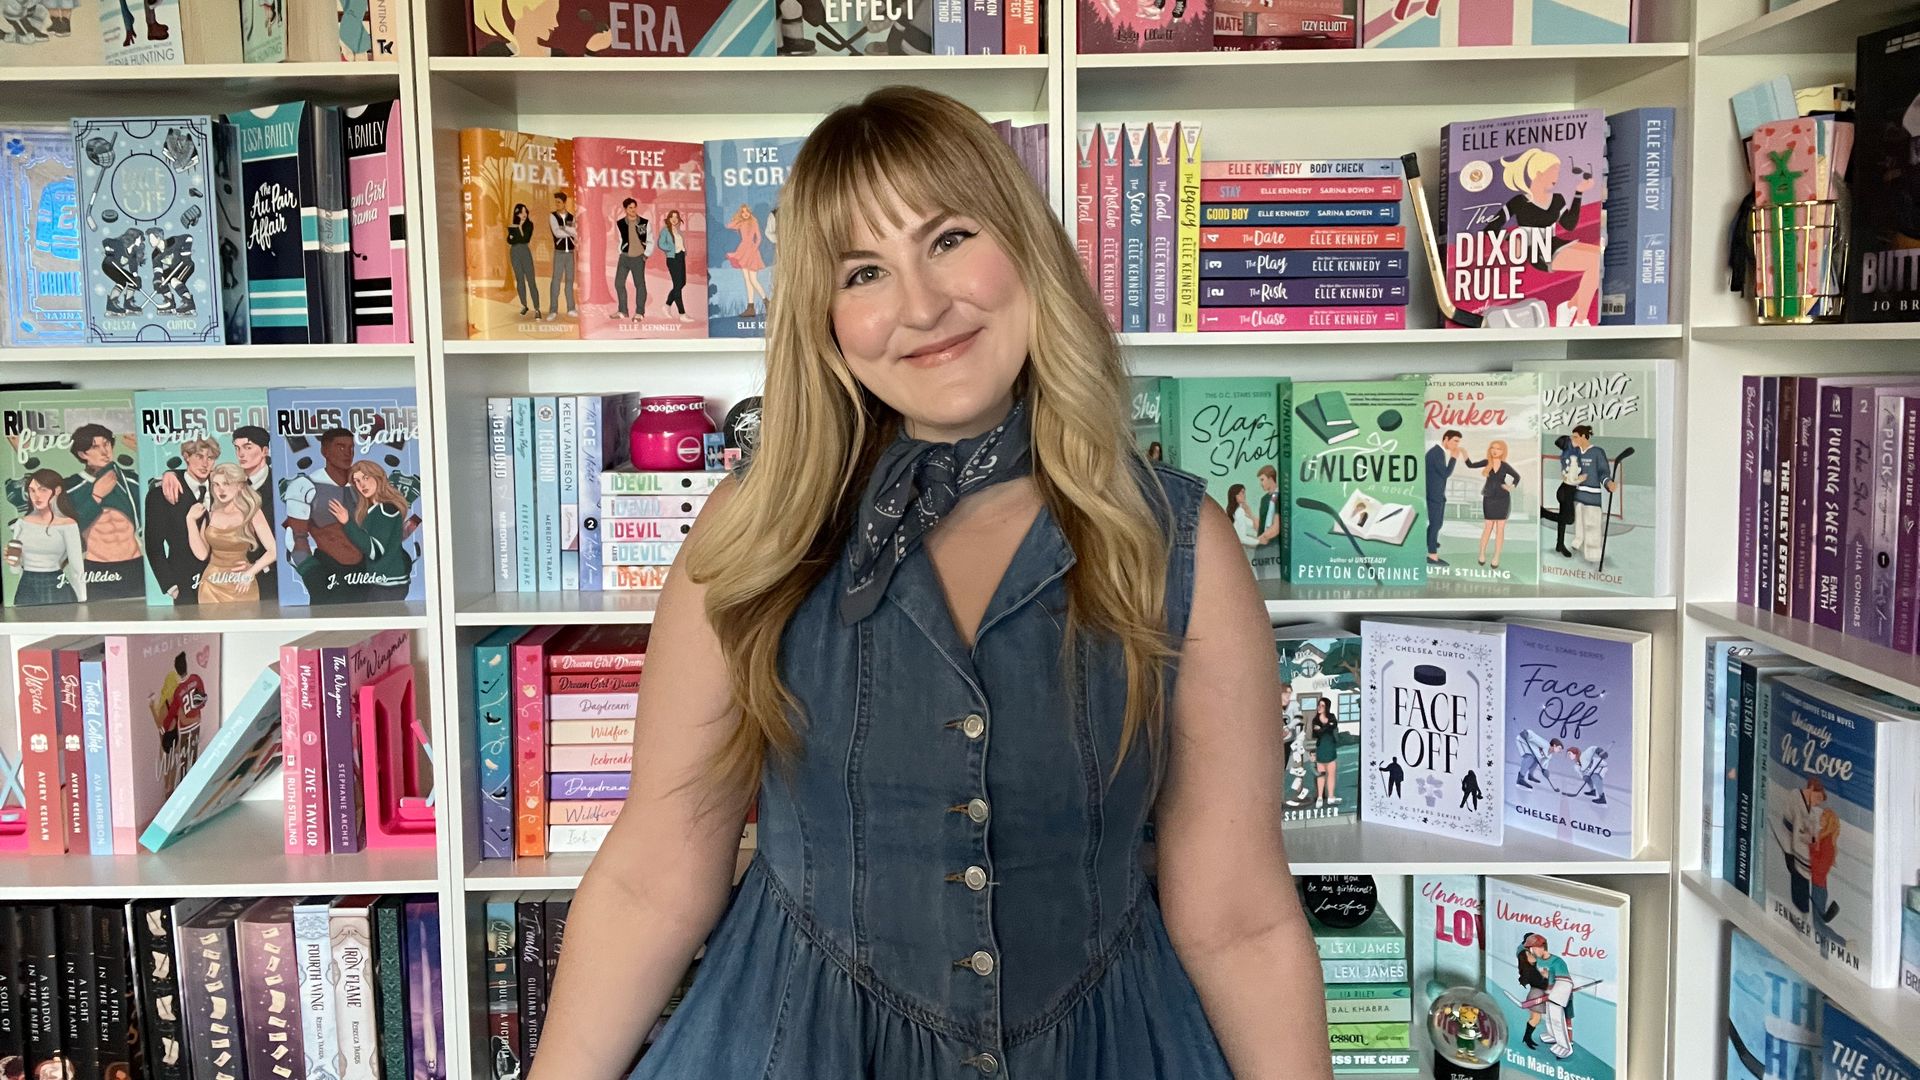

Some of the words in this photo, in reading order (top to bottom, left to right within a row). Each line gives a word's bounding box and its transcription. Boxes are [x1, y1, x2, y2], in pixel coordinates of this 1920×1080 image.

[826, 0, 914, 23] EFFECT
[1215, 17, 1243, 31] MATE
[609, 1, 685, 53] ERA
[1302, 21, 1318, 31] IZZY
[1319, 20, 1347, 31] ELLIOTT
[1462, 130, 1499, 151] ELLE
[1505, 121, 1588, 147] KENNEDY
[1647, 119, 1661, 148] ELLE
[526, 143, 557, 162] THE
[629, 150, 665, 167] THE
[743, 147, 780, 163] THE
[512, 165, 569, 187] DEAL
[586, 167, 703, 191] MISTAKE
[1228, 163, 1252, 175] ELLE
[1254, 163, 1302, 175] KENNEDY
[1310, 163, 1333, 174] BODY
[1335, 163, 1365, 174] CHECK
[1646, 153, 1660, 211] KENNEDY
[259, 182, 271, 195] The
[1130, 179, 1140, 190] The
[1220, 185, 1241, 198] STAY
[1260, 187, 1277, 195] ELLE
[1277, 187, 1312, 195] KENNEDY
[1347, 186, 1375, 194] BOWEN
[251, 191, 271, 219] Au
[271, 183, 298, 211] Pair
[1126, 191, 1145, 227] Score
[1206, 208, 1230, 220] GOOD
[1231, 208, 1249, 220] BOY
[1345, 209, 1373, 217] BOWEN
[1462, 203, 1502, 230] The
[247, 213, 288, 251] Affair
[1243, 235, 1253, 244] The
[1253, 230, 1287, 245] Dare
[1310, 233, 1333, 245] ELLE
[1335, 233, 1379, 245] KENNEDY
[1129, 238, 1140, 261] ELLE
[1456, 226, 1552, 268] DIXON
[1245, 260, 1257, 269] The
[1257, 255, 1288, 274] Play
[1312, 260, 1335, 272] ELLE
[1337, 260, 1381, 271] KENNEDY
[1128, 264, 1140, 307] KENNEDY
[1249, 287, 1260, 297] The
[1261, 282, 1288, 302] Risk
[1315, 288, 1338, 299] ELLE
[1340, 287, 1384, 299] KENNEDY
[1455, 266, 1525, 301] RULE
[102, 320, 137, 332] CHELSEA
[619, 323, 639, 332] ELLE
[641, 323, 682, 332] KENNEDY
[737, 321, 755, 330] ELLE
[1240, 314, 1250, 324] The
[1251, 309, 1287, 327] Chase
[1309, 315, 1332, 326] ELLE
[1334, 314, 1378, 325] KENNEDY
[1447, 392, 1485, 401] DEAD
[277, 408, 343, 435] RULES
[349, 408, 376, 433] OF
[383, 407, 417, 432] THE
[563, 403, 571, 433] KELLY
[1191, 404, 1274, 443] Slap
[1424, 400, 1509, 430] Rinker
[17, 429, 74, 464] five
[355, 425, 419, 454] Game
[492, 415, 506, 479] ICEBOUND
[1881, 428, 1894, 476] PUCK
[564, 437, 572, 492] JAMIESON
[1210, 430, 1280, 477] Shot
[1826, 428, 1843, 495] PUCKING
[614, 473, 662, 491] DEVIL
[1300, 454, 1418, 483] UNLOVED
[1780, 460, 1791, 495] THE
[498, 511, 507, 553] MEREDITH
[586, 520, 595, 530] 2
[614, 522, 662, 538] DEVIL
[1779, 498, 1790, 541] RILEY
[1823, 501, 1840, 557] SWEET
[500, 556, 508, 580] TRAPP
[1761, 543, 1769, 590] KEELAN
[1855, 540, 1863, 570] JULIA
[327, 573, 341, 589] J.
[344, 571, 390, 585] Wilder
[1298, 565, 1352, 580] PEYTON
[1357, 565, 1419, 581] CORINNE
[1455, 567, 1511, 580] STILLING
[1588, 568, 1623, 585] NICOLE
[1777, 544, 1789, 606] EFFECT
[1820, 574, 1829, 610] RATH
[1829, 575, 1838, 614] EMILY
[1853, 573, 1862, 628] CONNORS
[333, 655, 346, 674] The
[351, 650, 366, 673] The
[366, 632, 410, 678] Wingman
[1395, 645, 1434, 658] CHELSEA
[1436, 649, 1465, 660] CURTO
[22, 664, 50, 715] Offside
[300, 665, 312, 709] Moment
[1520, 662, 1605, 700] Face
[328, 675, 347, 719] Wingman
[579, 699, 632, 714] Daydream
[1393, 686, 1469, 736] FACE
[1538, 696, 1599, 739] Off
[591, 726, 630, 741] Wildfire
[1791, 710, 1833, 749] Uniquely
[1401, 728, 1460, 774] OFF
[1780, 734, 1798, 766] In
[1803, 742, 1854, 782] Love
[37, 771, 47, 801] AVERY
[287, 777, 296, 802] RUTH
[337, 763, 347, 810] STEPHANIE
[564, 777, 630, 796] Daydream
[40, 803, 49, 841] KEELAN
[288, 804, 298, 845] STILLING
[305, 803, 317, 847] TAYLOR
[566, 806, 619, 823] Wildfire
[1284, 807, 1339, 822] SCHUYLER
[1515, 804, 1568, 828] CHELSEA
[1570, 818, 1612, 839] CURTO
[341, 813, 349, 847] ARCHER
[1496, 898, 1595, 940] Unmasking
[1331, 942, 1356, 954] LEXI
[1360, 942, 1401, 954] JAMES
[1561, 937, 1608, 960] Love
[67, 962, 75, 974] IN
[1335, 966, 1360, 979] LEXI
[1364, 966, 1405, 979] JAMES
[67, 979, 76, 1000] THE
[527, 977, 537, 1022] GIULIANA
[40, 986, 51, 1032] SHADOW
[68, 1004, 78, 1039] FLAME
[1331, 1005, 1349, 1014] BAL
[1351, 1005, 1391, 1014] KHABRA
[1332, 1055, 1349, 1065] ISS
[1350, 1055, 1375, 1065] THE
[1377, 1055, 1411, 1065] CHEF
[1831, 1040, 1869, 1078] THE
